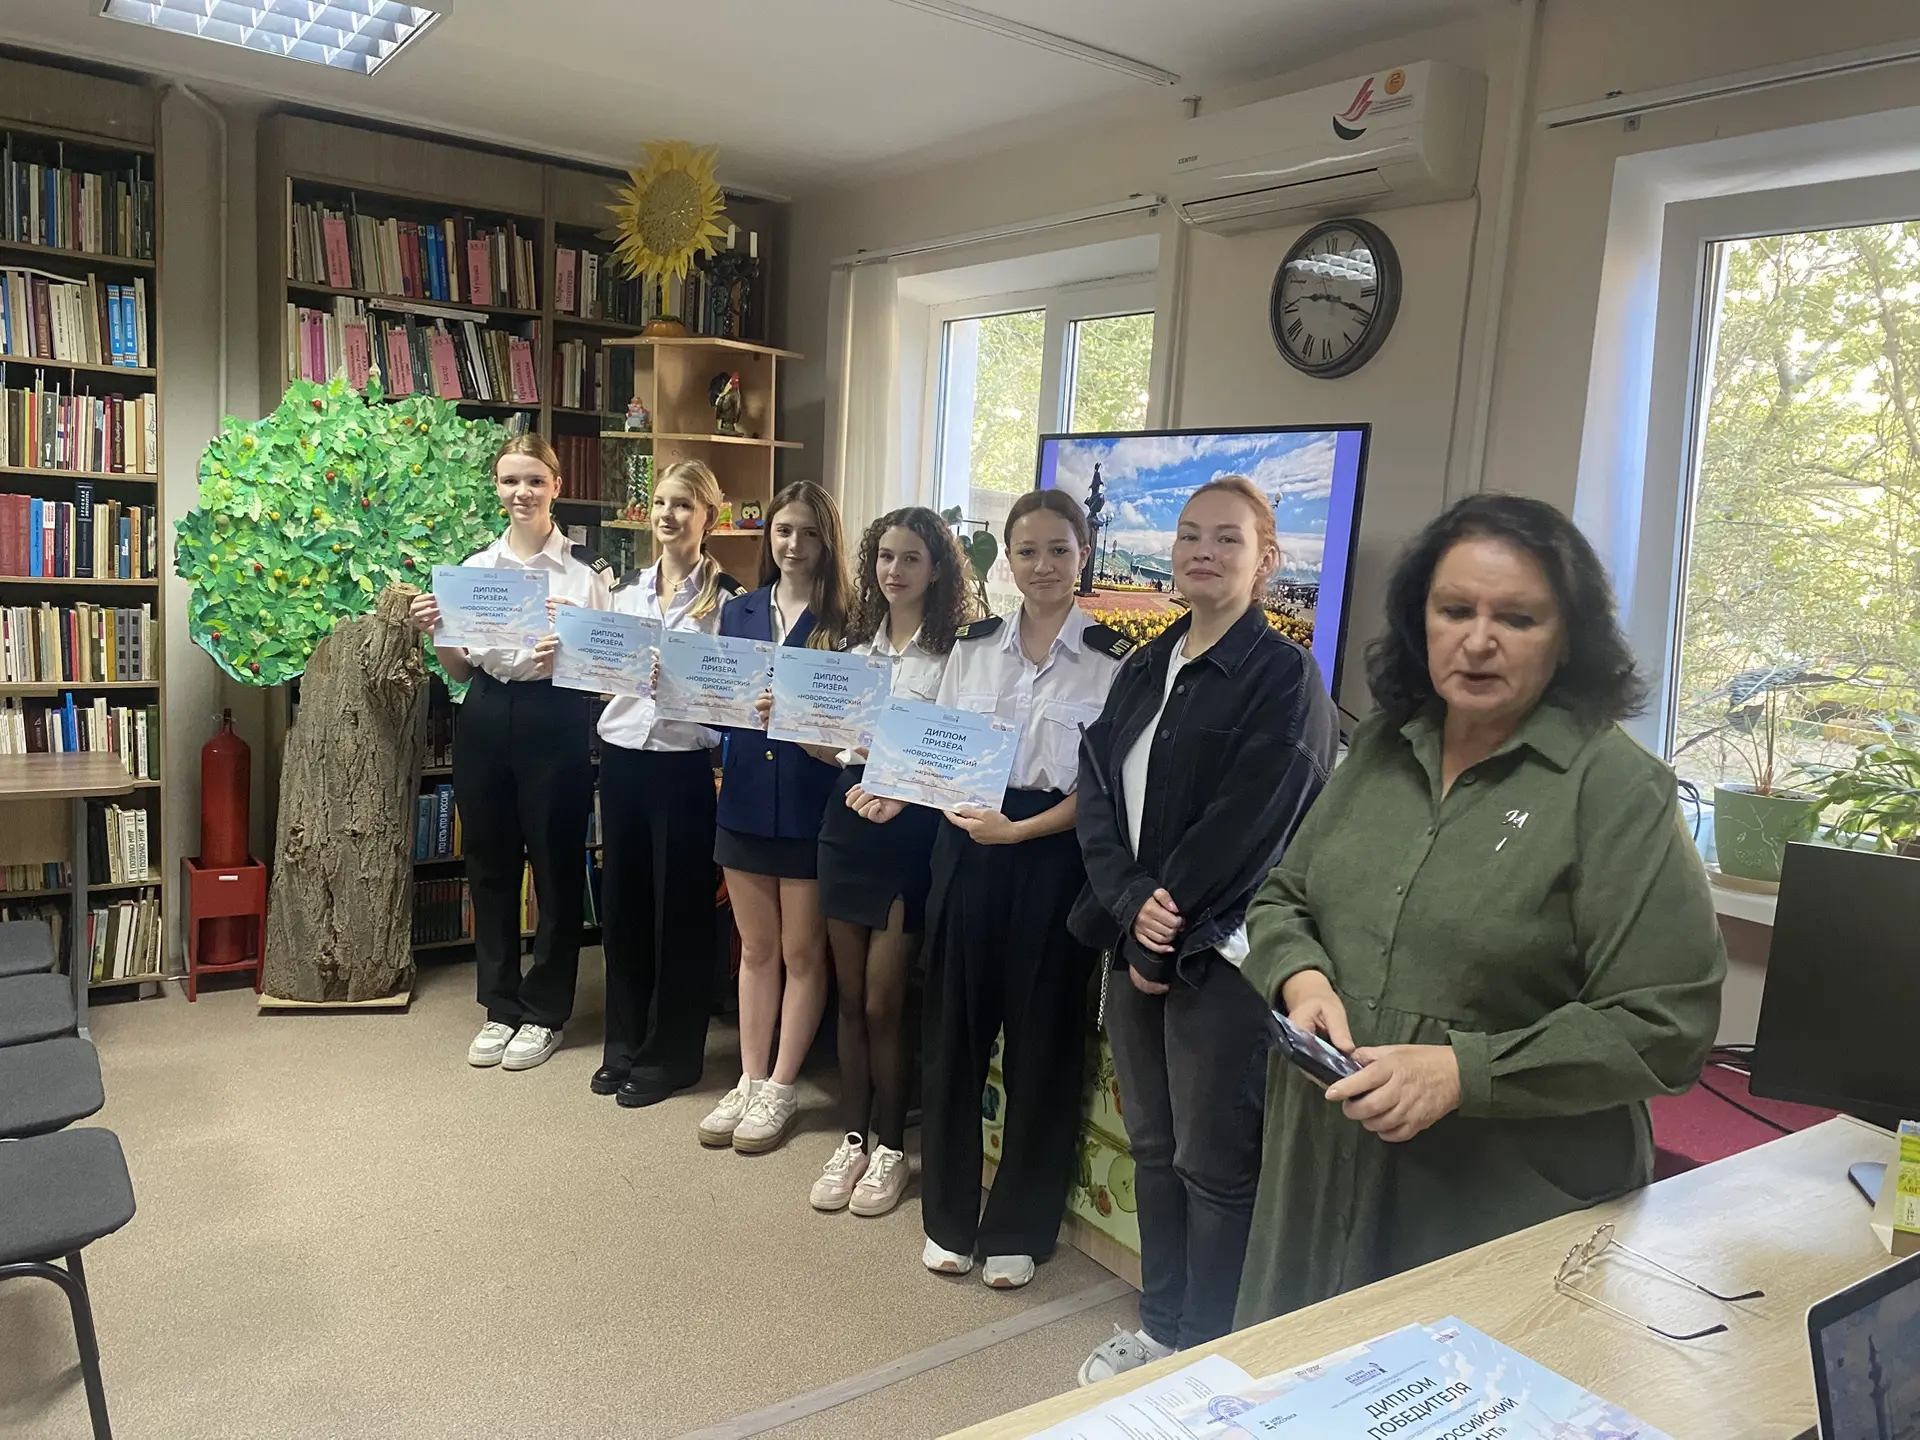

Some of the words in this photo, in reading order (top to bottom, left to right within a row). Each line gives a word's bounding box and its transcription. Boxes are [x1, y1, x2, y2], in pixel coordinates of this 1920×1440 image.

[590, 629, 624, 639] ДИПЛОМ
[702, 655, 738, 666] ДИПЛОМ
[813, 672, 849, 682] ДИПЛОМ
[797, 693, 862, 706] «НОВОРОССИЙСКИЙ
[924, 728, 967, 742] ДИПЛОМ
[902, 748, 978, 768] «НОВОРОССИЙСКИЙ
[918, 758, 956, 771] ДИКТАНТ»
[440, 791, 449, 812] РОССИИ
[128, 844, 136, 869] ПОЗНАЮ
[138, 842, 146, 868] ПОЗНАЮ
[1365, 1376, 1438, 1420] ДИПЛОМ
[1367, 1382, 1472, 1440] ПОБЕДИТЕЛЯ
